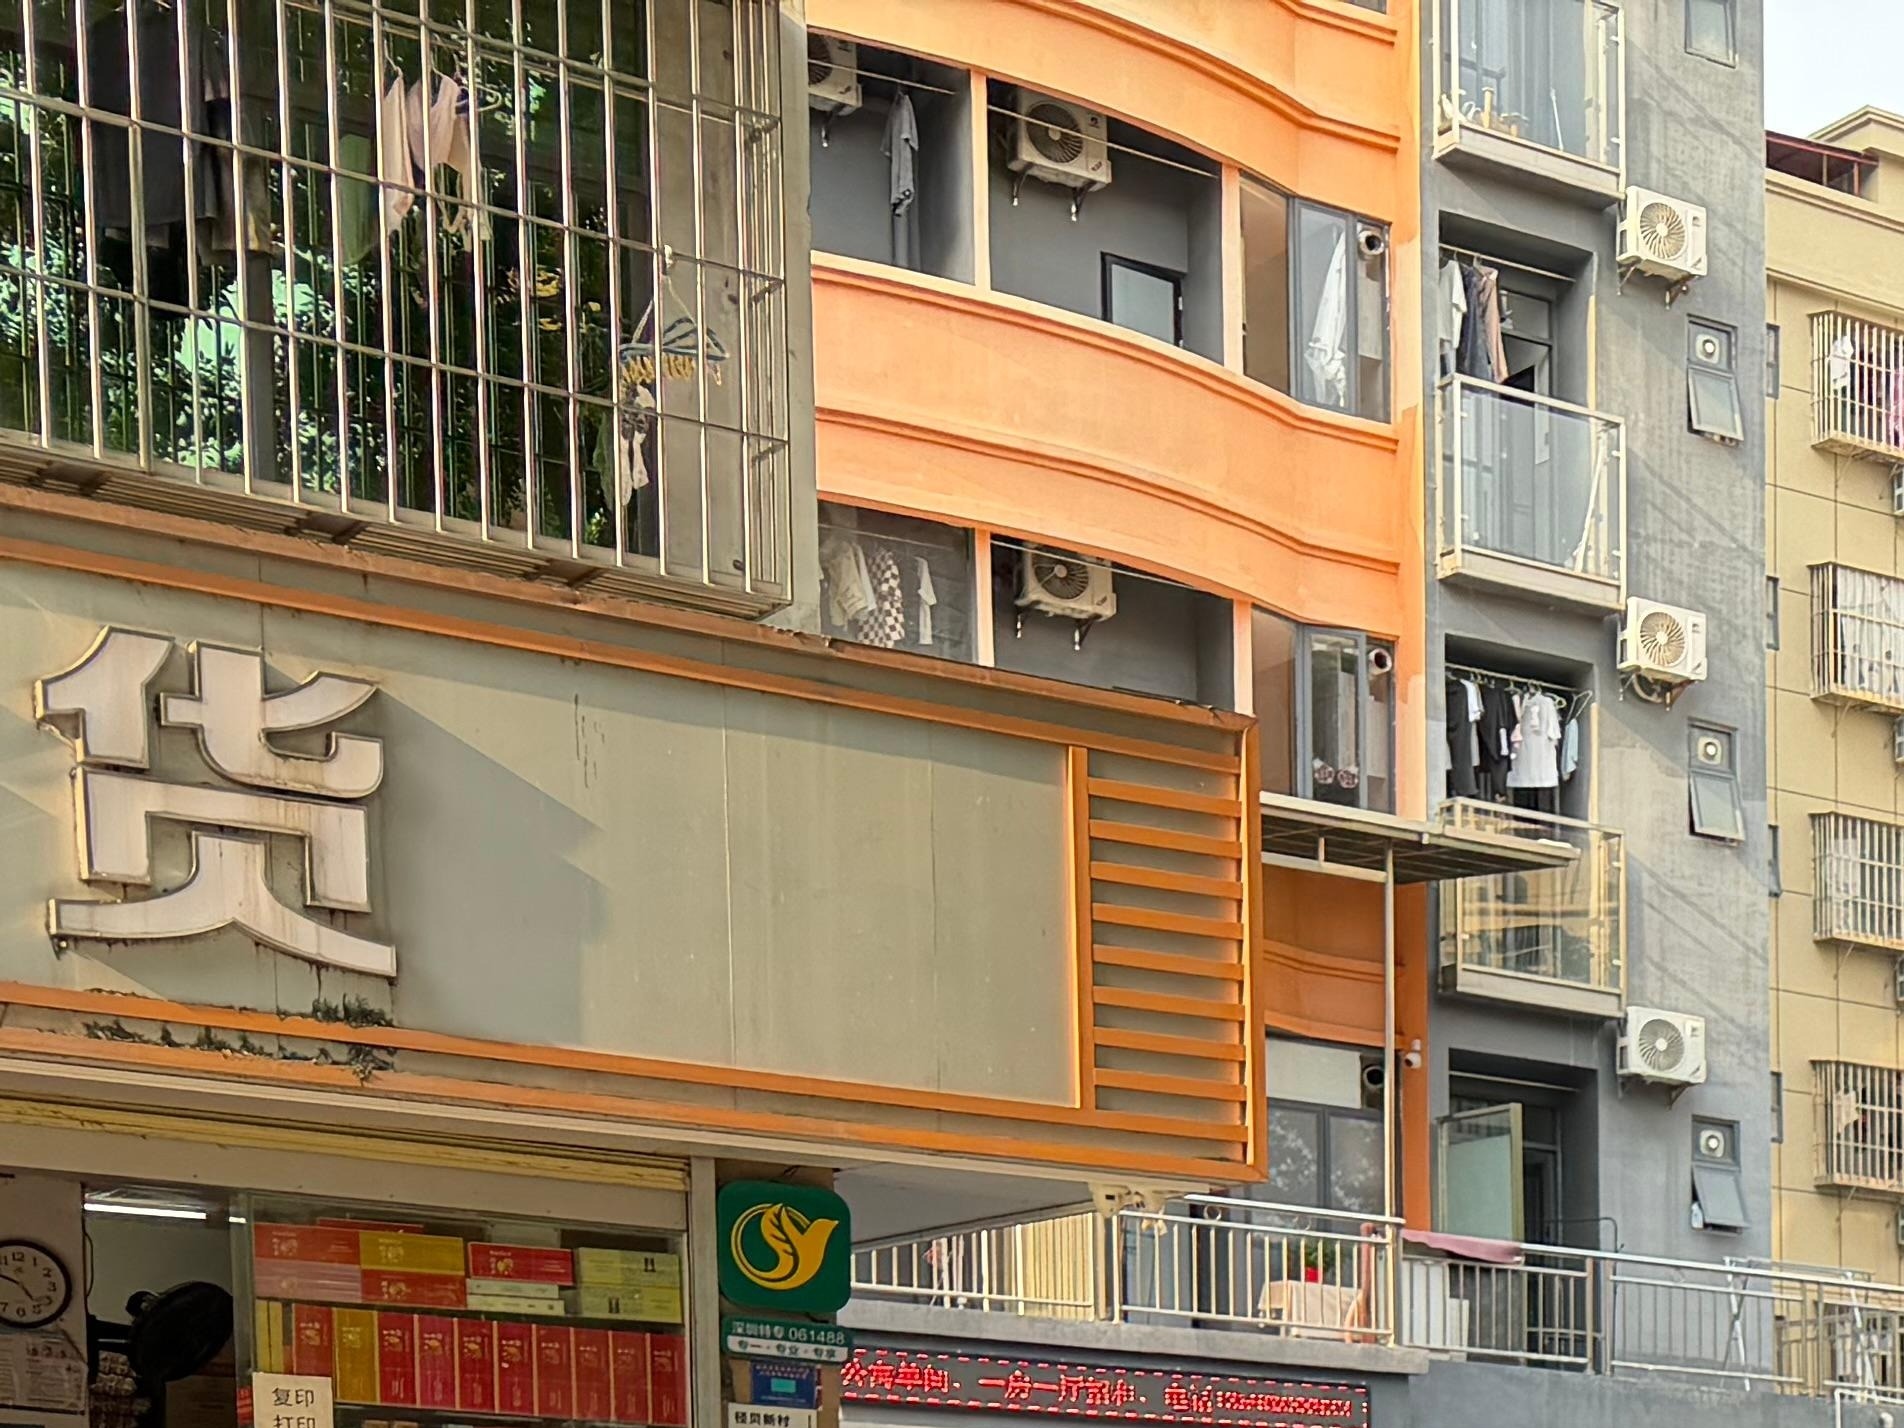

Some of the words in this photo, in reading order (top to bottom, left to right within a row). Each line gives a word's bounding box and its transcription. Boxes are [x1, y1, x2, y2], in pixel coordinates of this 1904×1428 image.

[33, 624, 398, 978] 货
[788, 1327, 845, 1345] 061488
[272, 1387, 315, 1407] 复印
